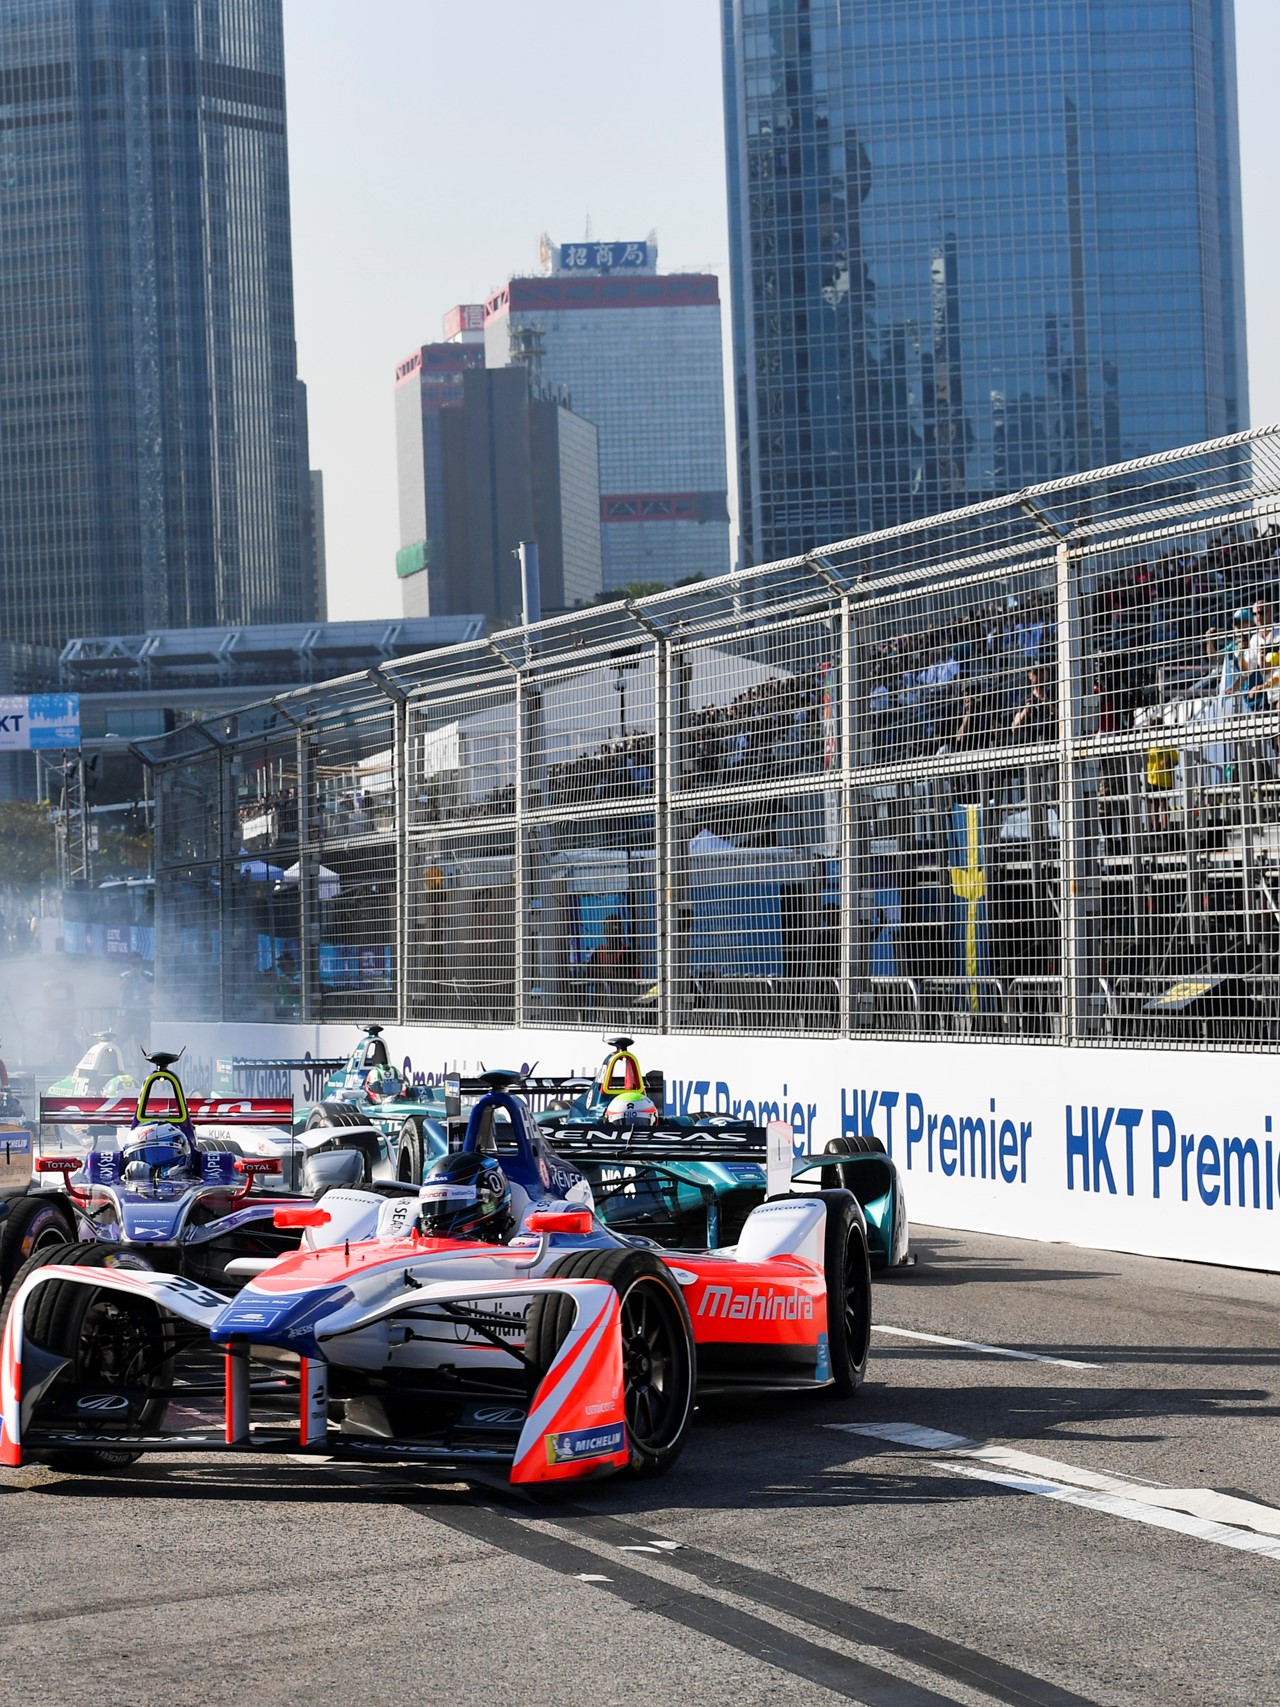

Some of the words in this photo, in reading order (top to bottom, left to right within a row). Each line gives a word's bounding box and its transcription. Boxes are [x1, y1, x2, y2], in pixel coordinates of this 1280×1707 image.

[566, 244, 643, 266] 招商局
[209, 1129, 231, 1140] KUKA
[539, 1126, 748, 1143] RENESAS
[841, 1088, 899, 1161] HKT
[906, 1092, 1032, 1184] Premier
[45, 1160, 78, 1169] TOTAL
[1065, 1105, 1144, 1197] HKT
[1152, 1109, 1280, 1211] Premi
[241, 1163, 272, 1171] TOTAL
[420, 1190, 448, 1199] ahindra
[697, 1285, 814, 1320] Mahindra
[585, 1400, 616, 1415] umicore
[575, 1432, 621, 1452] MICHELIN
